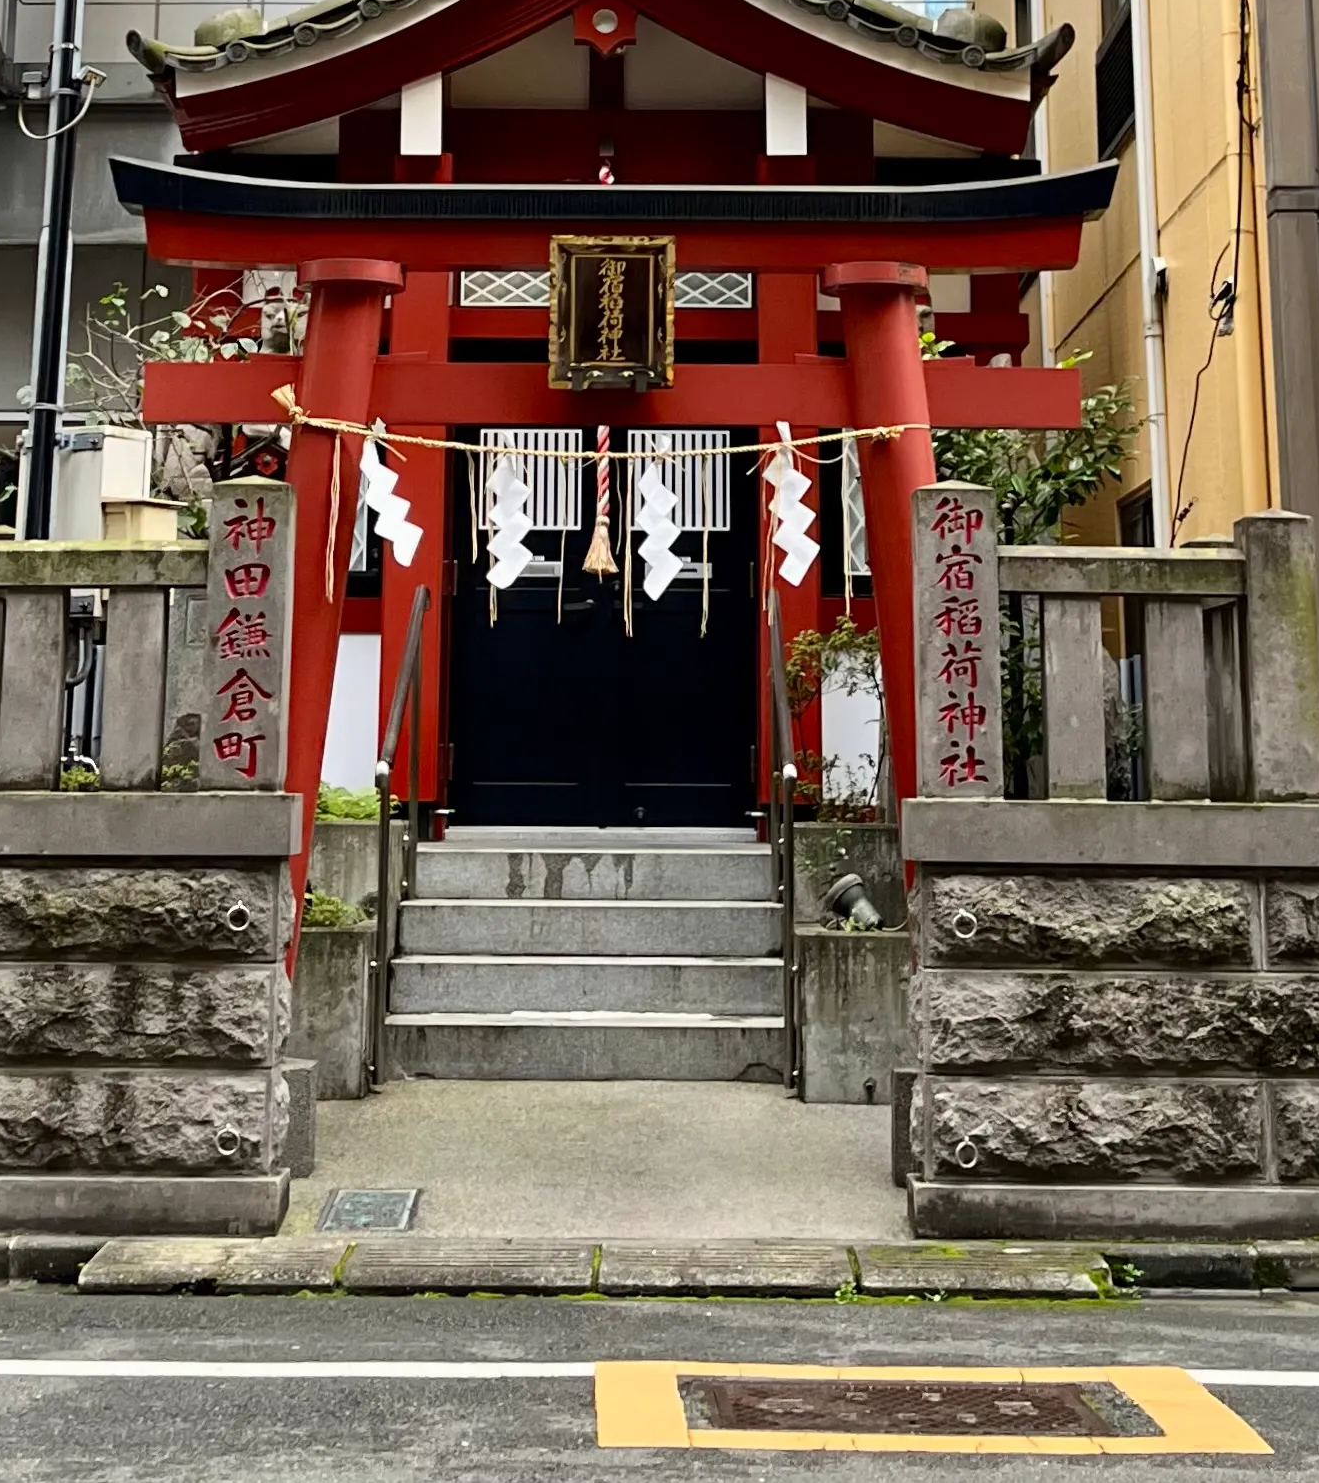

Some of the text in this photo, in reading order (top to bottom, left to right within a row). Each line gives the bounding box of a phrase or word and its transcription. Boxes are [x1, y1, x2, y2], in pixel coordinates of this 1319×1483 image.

[213, 496, 277, 780] 神田鎌倉町
